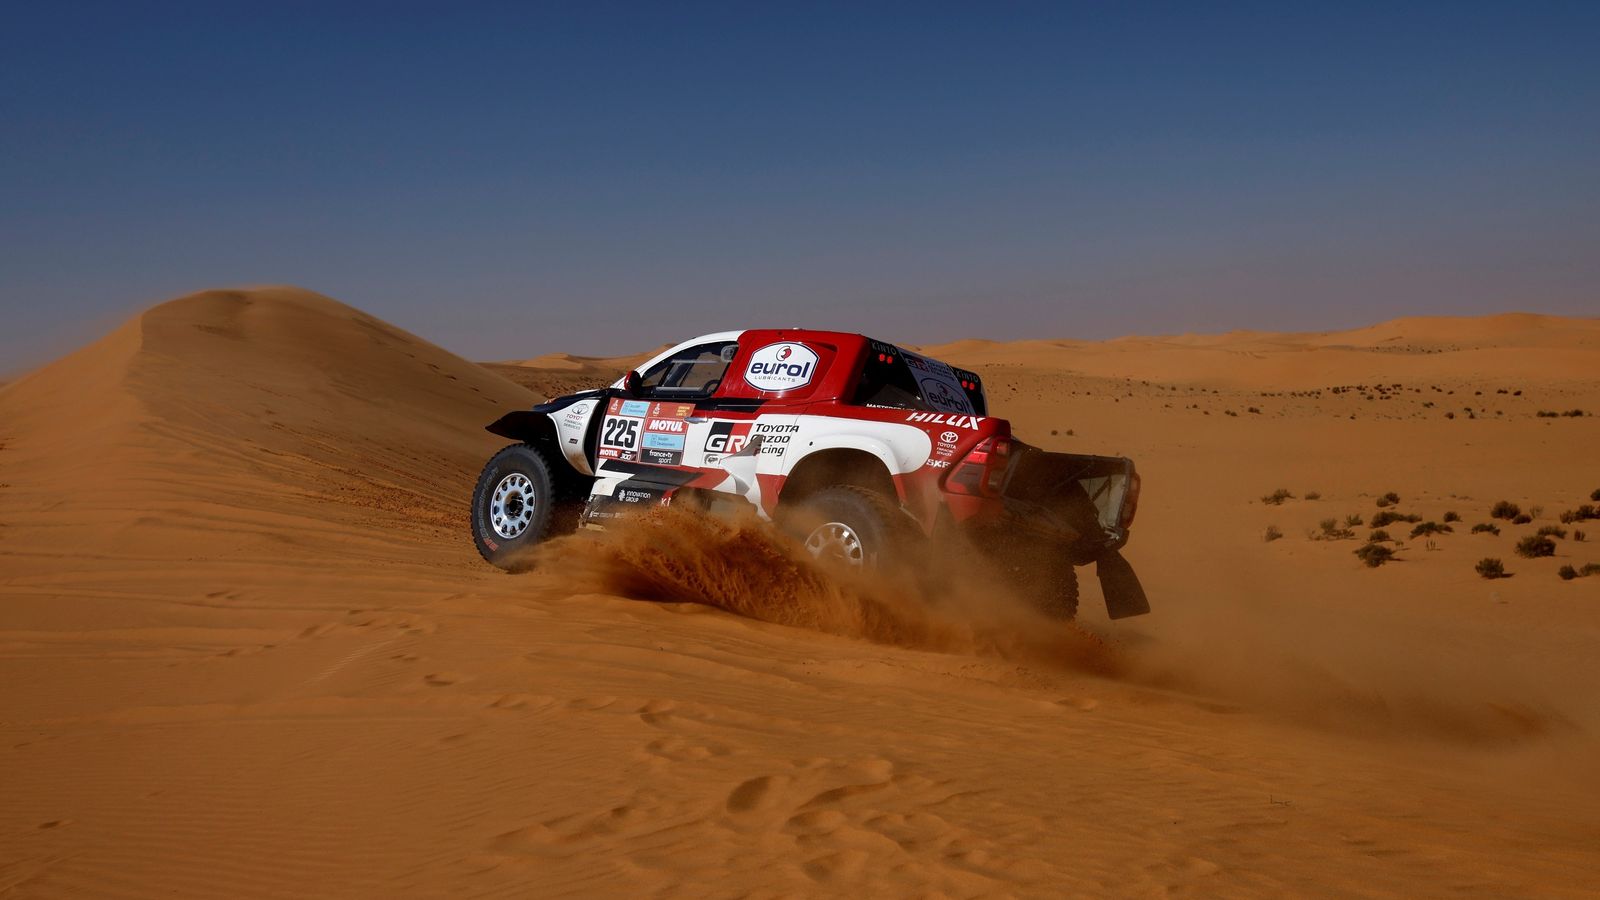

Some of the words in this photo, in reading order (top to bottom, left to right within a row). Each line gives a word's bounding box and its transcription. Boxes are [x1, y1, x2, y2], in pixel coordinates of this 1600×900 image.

[750, 362, 811, 378] eurol
[754, 375, 796, 383] LUBRICANTS
[649, 419, 683, 433] MOTUL
[905, 412, 986, 431] HILUX
[604, 418, 639, 449] 225
[756, 424, 799, 433] TOYOTA
[706, 433, 746, 453] GR
[936, 441, 957, 450] TOYOTA
[599, 448, 619, 458] MOTUL
[658, 457, 673, 465] sport
[926, 458, 951, 468] SKF
